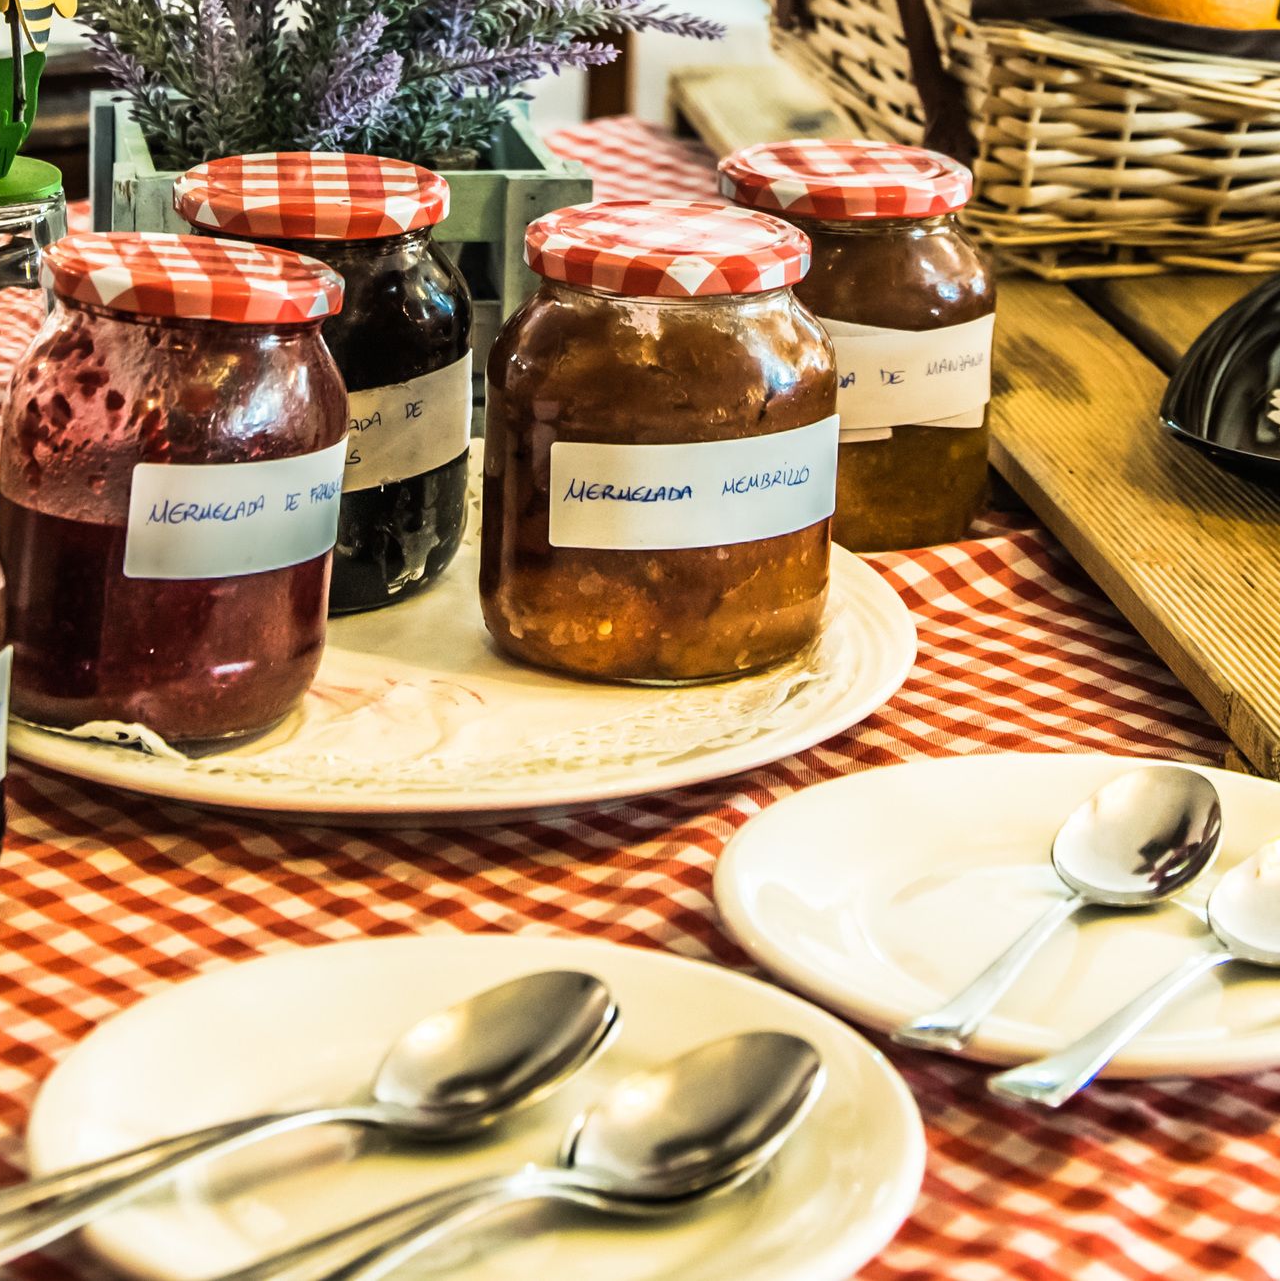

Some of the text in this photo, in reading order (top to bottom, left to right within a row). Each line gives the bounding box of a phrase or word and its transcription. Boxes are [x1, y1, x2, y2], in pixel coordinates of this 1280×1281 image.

[880, 368, 906, 387] DE
[405, 400, 424, 420] DE
[563, 461, 810, 503] MERMELADA MEMBRILLO
[146, 494, 265, 525] MERMELADA
[284, 492, 301, 512] DE
